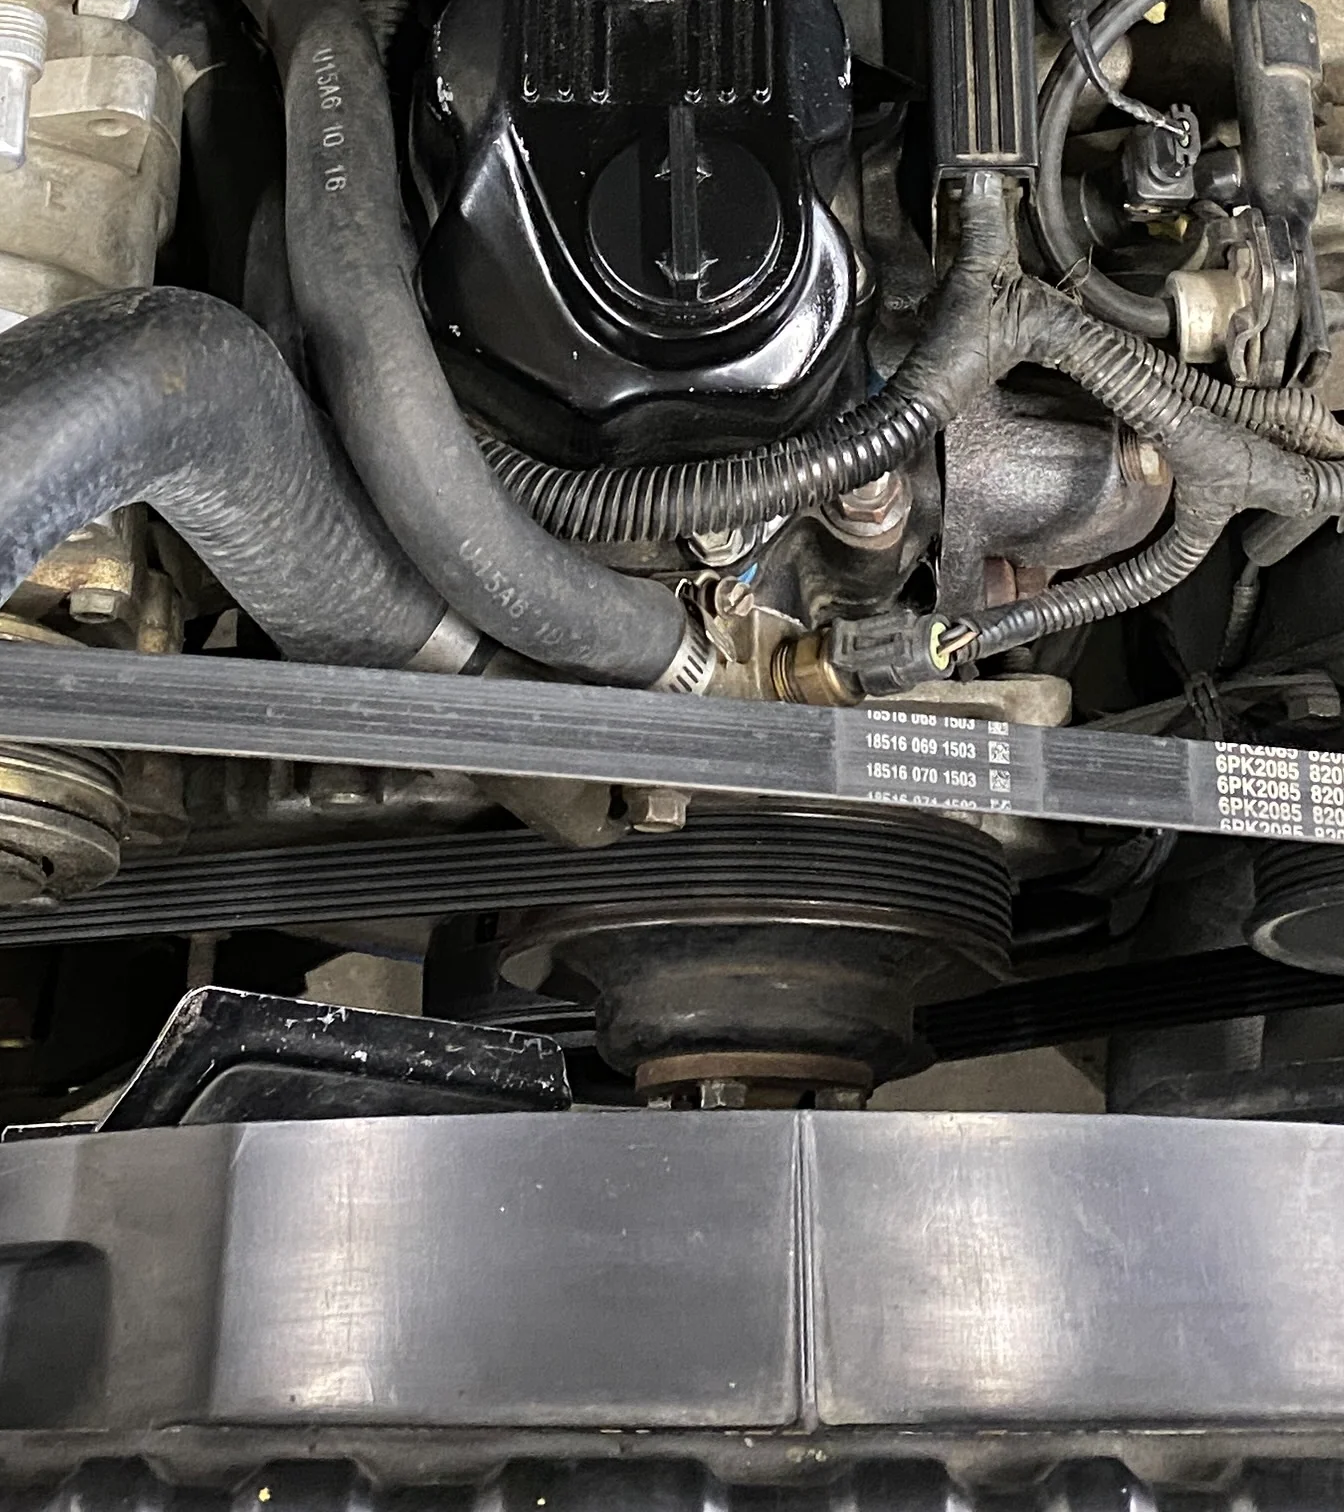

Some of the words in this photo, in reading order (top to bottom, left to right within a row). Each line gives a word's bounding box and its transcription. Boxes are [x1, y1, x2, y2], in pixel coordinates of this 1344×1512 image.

[312, 47, 343, 110] U15A6
[324, 164, 346, 192] 16
[866, 733, 907, 752] 18516
[911, 737, 938, 755] 069
[942, 740, 977, 759] 1503
[866, 762, 908, 781] 18516
[912, 766, 938, 784] 070
[943, 770, 977, 788] 1503
[1216, 754, 1300, 781] 6PK2085
[1217, 775, 1301, 802] 6PK2085
[1218, 796, 1303, 822] 6PK2085
